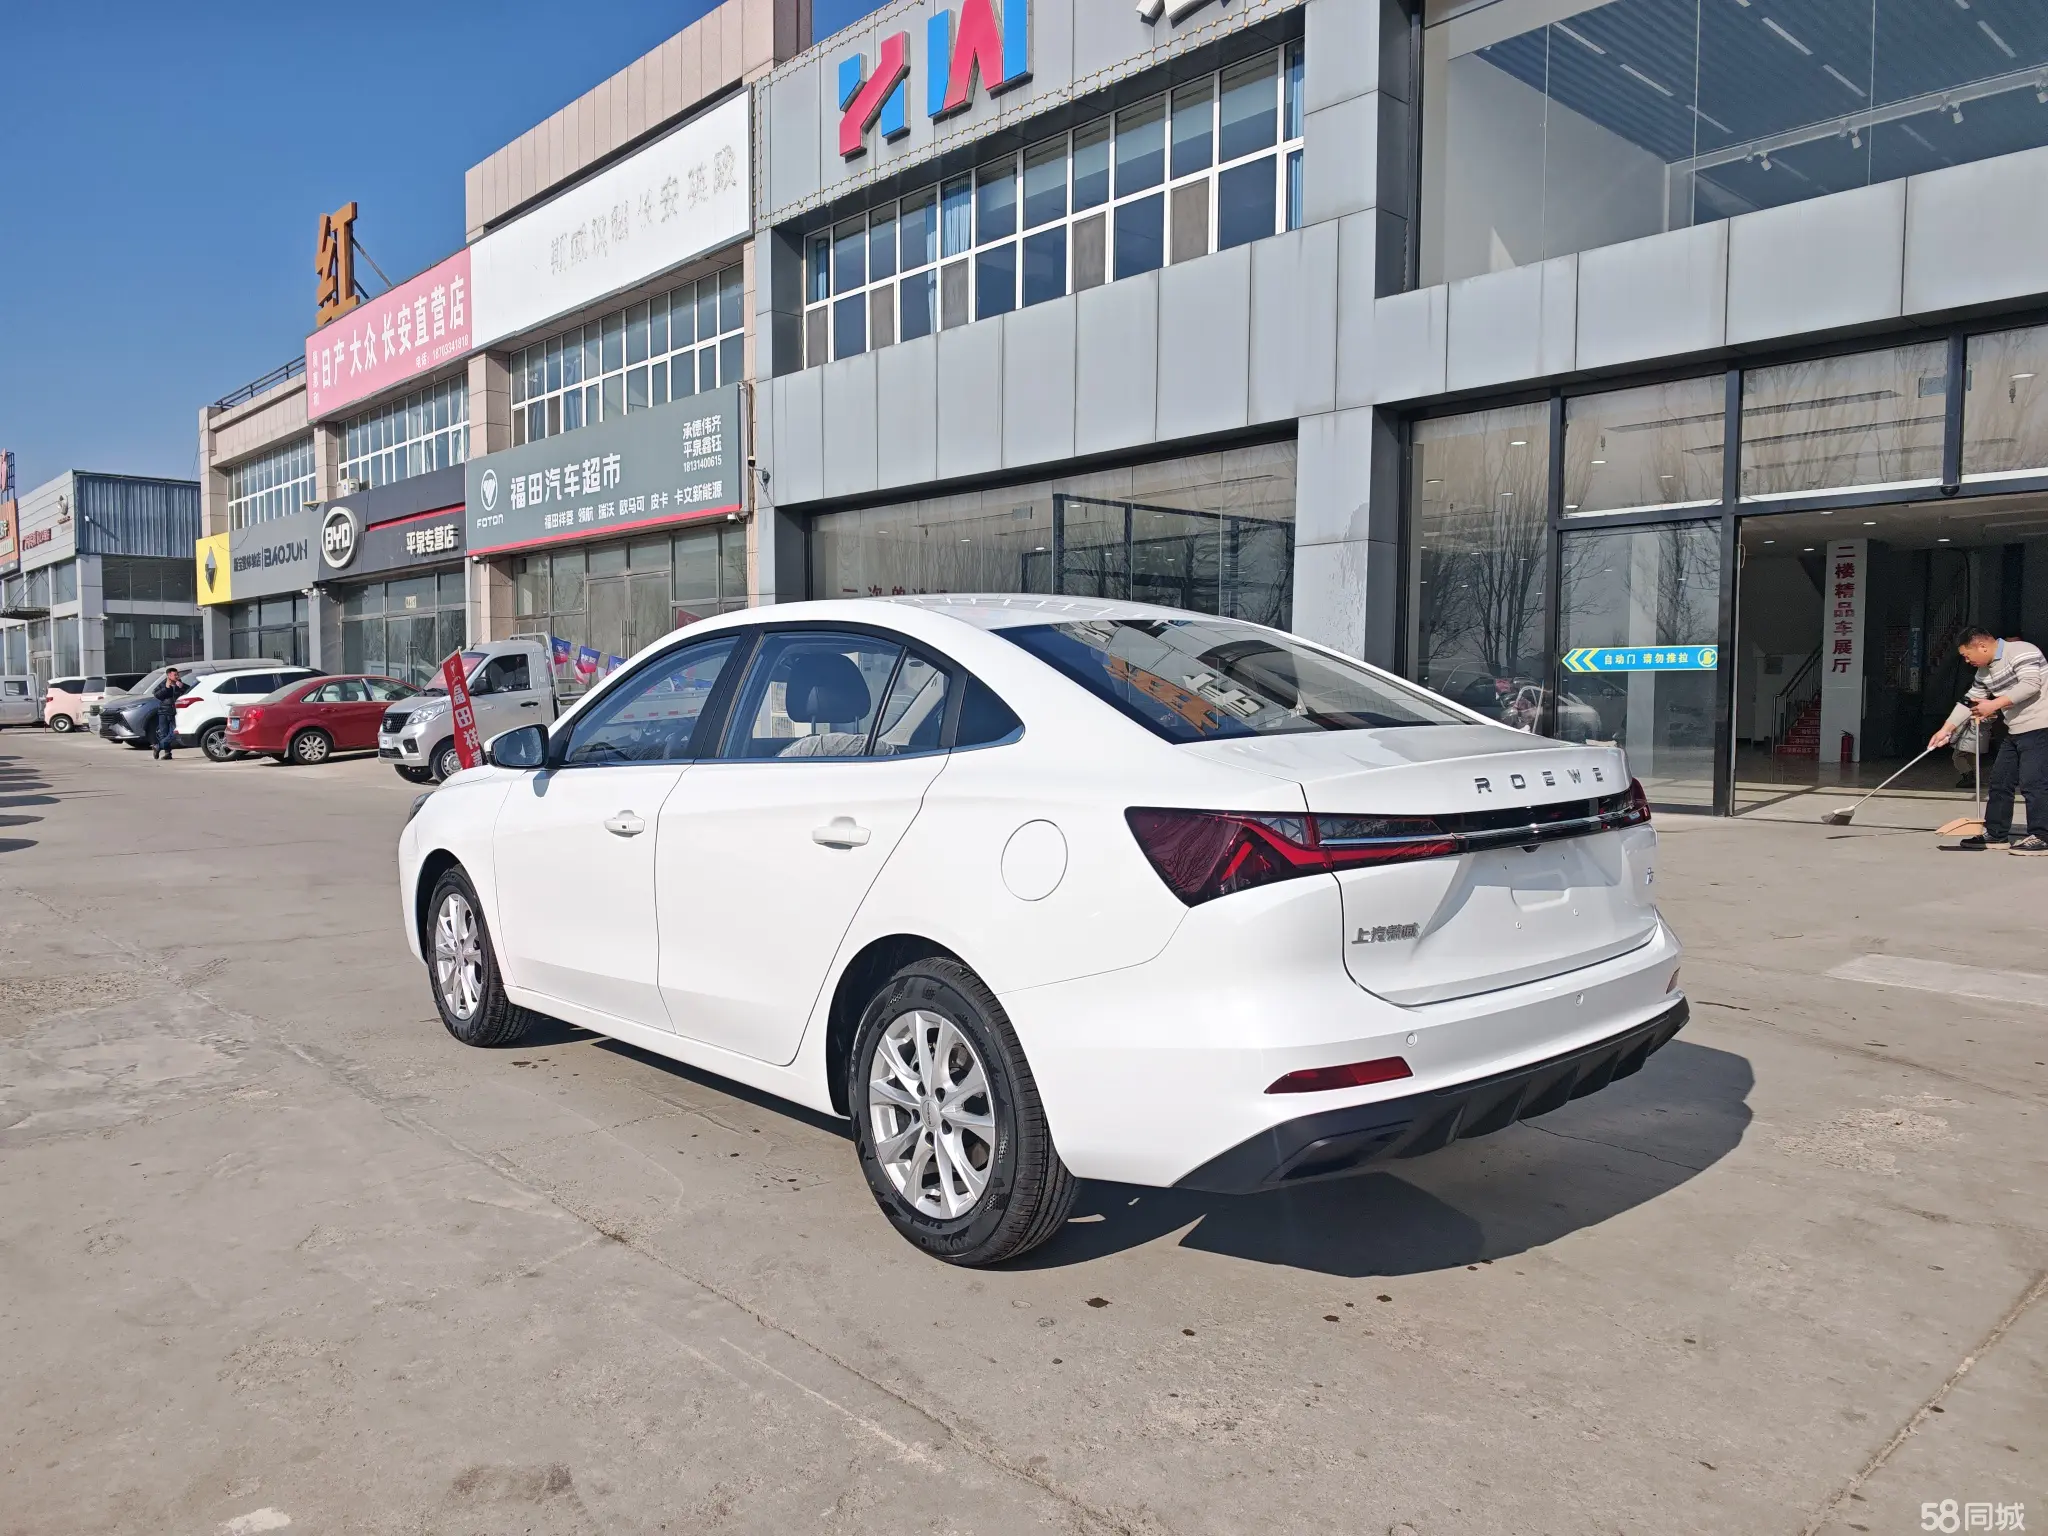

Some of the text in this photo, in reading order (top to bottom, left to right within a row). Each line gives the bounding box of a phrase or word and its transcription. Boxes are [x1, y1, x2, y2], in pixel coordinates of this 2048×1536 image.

[322, 337, 345, 389] 日产
[350, 322, 377, 377] 大众
[381, 274, 464, 362] 长安直营店
[432, 334, 469, 360] 18703341818
[682, 415, 721, 439] 承德伟齐
[683, 434, 721, 458] 平泉鑫钰
[683, 455, 722, 472] 18131400615
[511, 452, 621, 511] 福田汽车超市
[544, 480, 723, 530] 福田祥菱 领航 瑞沃 欧马可 皮卡 卡文新能源
[476, 513, 504, 529] FOTON
[325, 522, 351, 551] BYD
[406, 523, 456, 555] 平泉专营店
[264, 538, 308, 568] BAOJUN
[1831, 545, 1856, 674] 二楼精品车展厅
[1604, 651, 1689, 666] 自动门 请勿推拉
[1474, 767, 1604, 794] ROEWE
